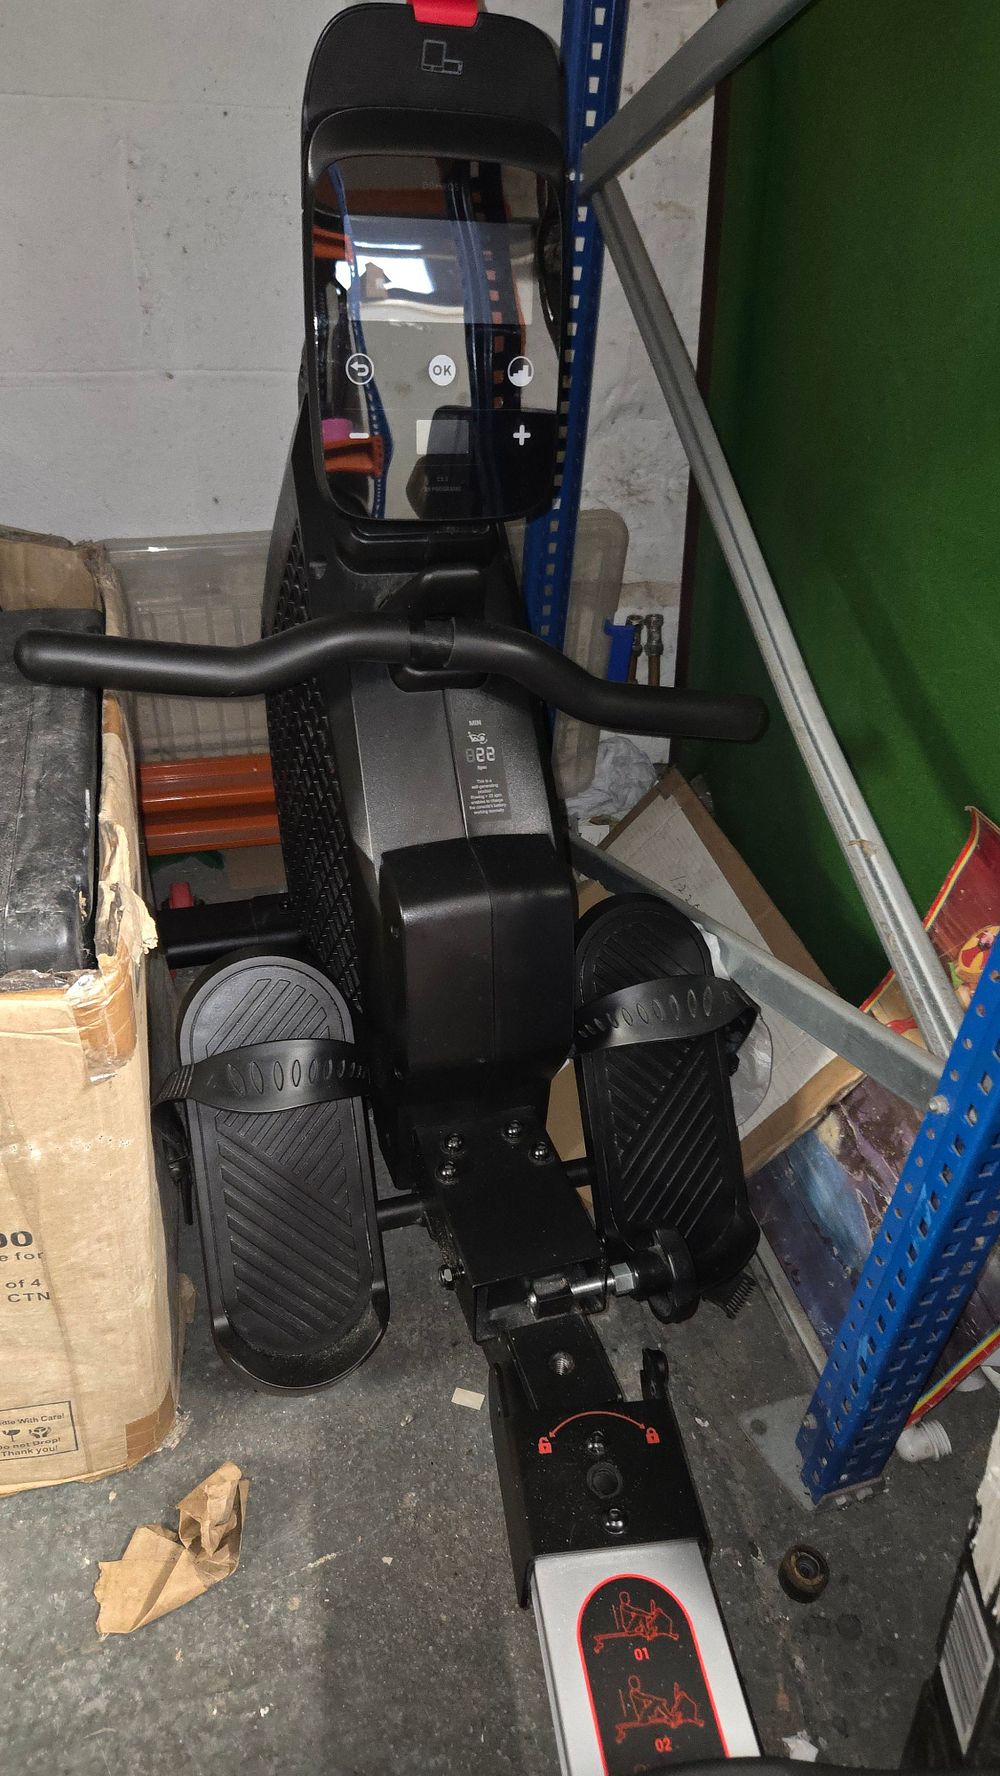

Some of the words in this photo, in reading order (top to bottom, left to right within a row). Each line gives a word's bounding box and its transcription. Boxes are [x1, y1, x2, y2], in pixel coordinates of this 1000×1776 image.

[432, 365, 452, 376] OK
[15, 1251, 43, 1260] for
[6, 1279, 24, 1288] of
[31, 1278, 41, 1287] 4
[8, 1292, 50, 1303] CTN
[18, 1416, 39, 1424] With
[33, 1437, 61, 1446] Drop!
[3, 1449, 33, 1457] Thank
[36, 1445, 57, 1454] you!
[634, 1647, 650, 1661] 01
[655, 1737, 672, 1752] 02
